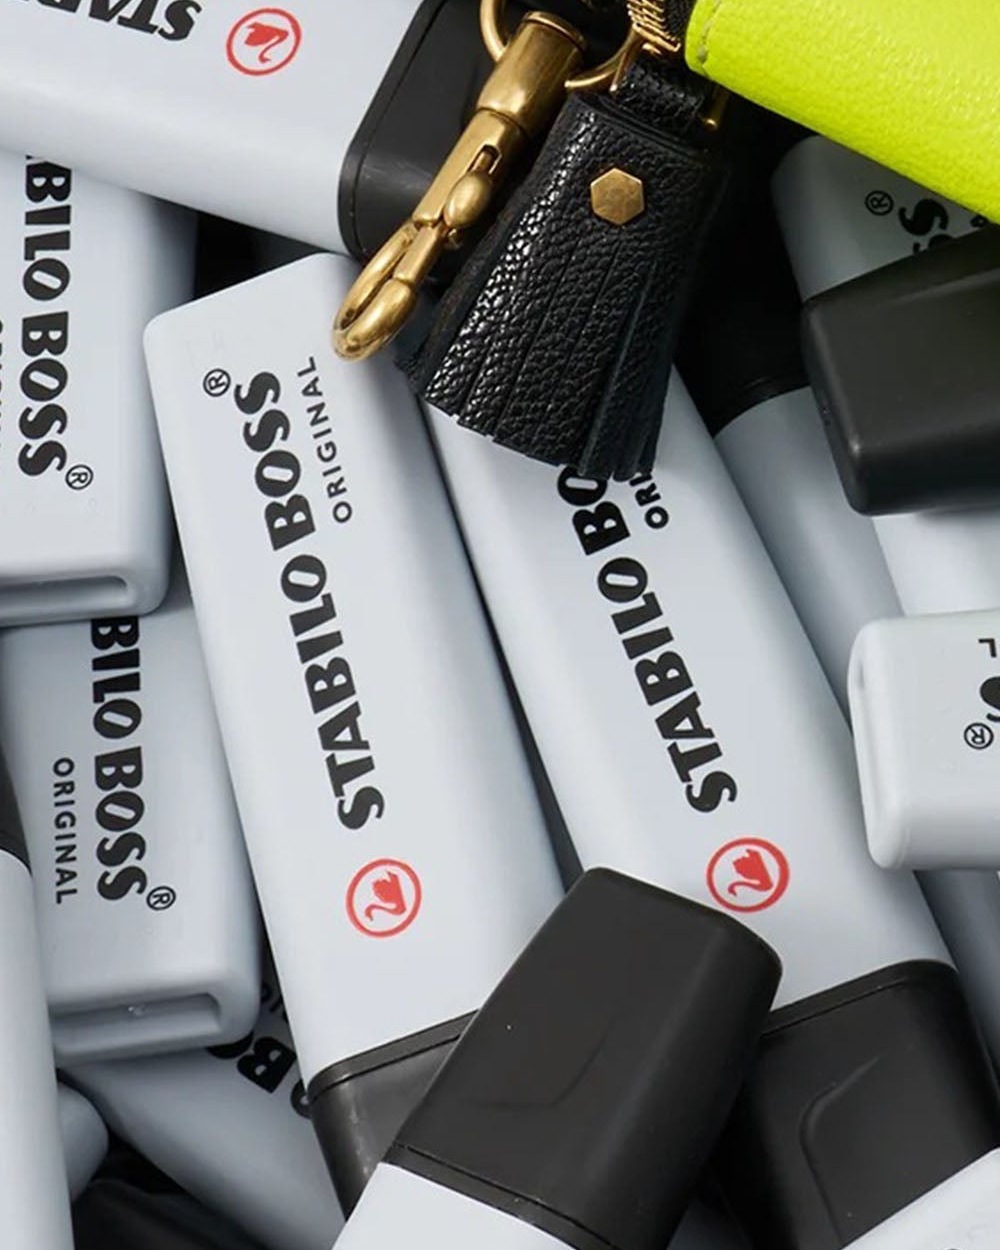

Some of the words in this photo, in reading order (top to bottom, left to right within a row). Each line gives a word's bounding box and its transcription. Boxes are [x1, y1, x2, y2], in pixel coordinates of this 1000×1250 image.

[22, 154, 73, 302] BILO
[296, 355, 354, 524] ORIGINAL
[280, 553, 386, 831] STABILO
[596, 556, 739, 814] STABILO
[52, 756, 79, 906] ORIGINAL
